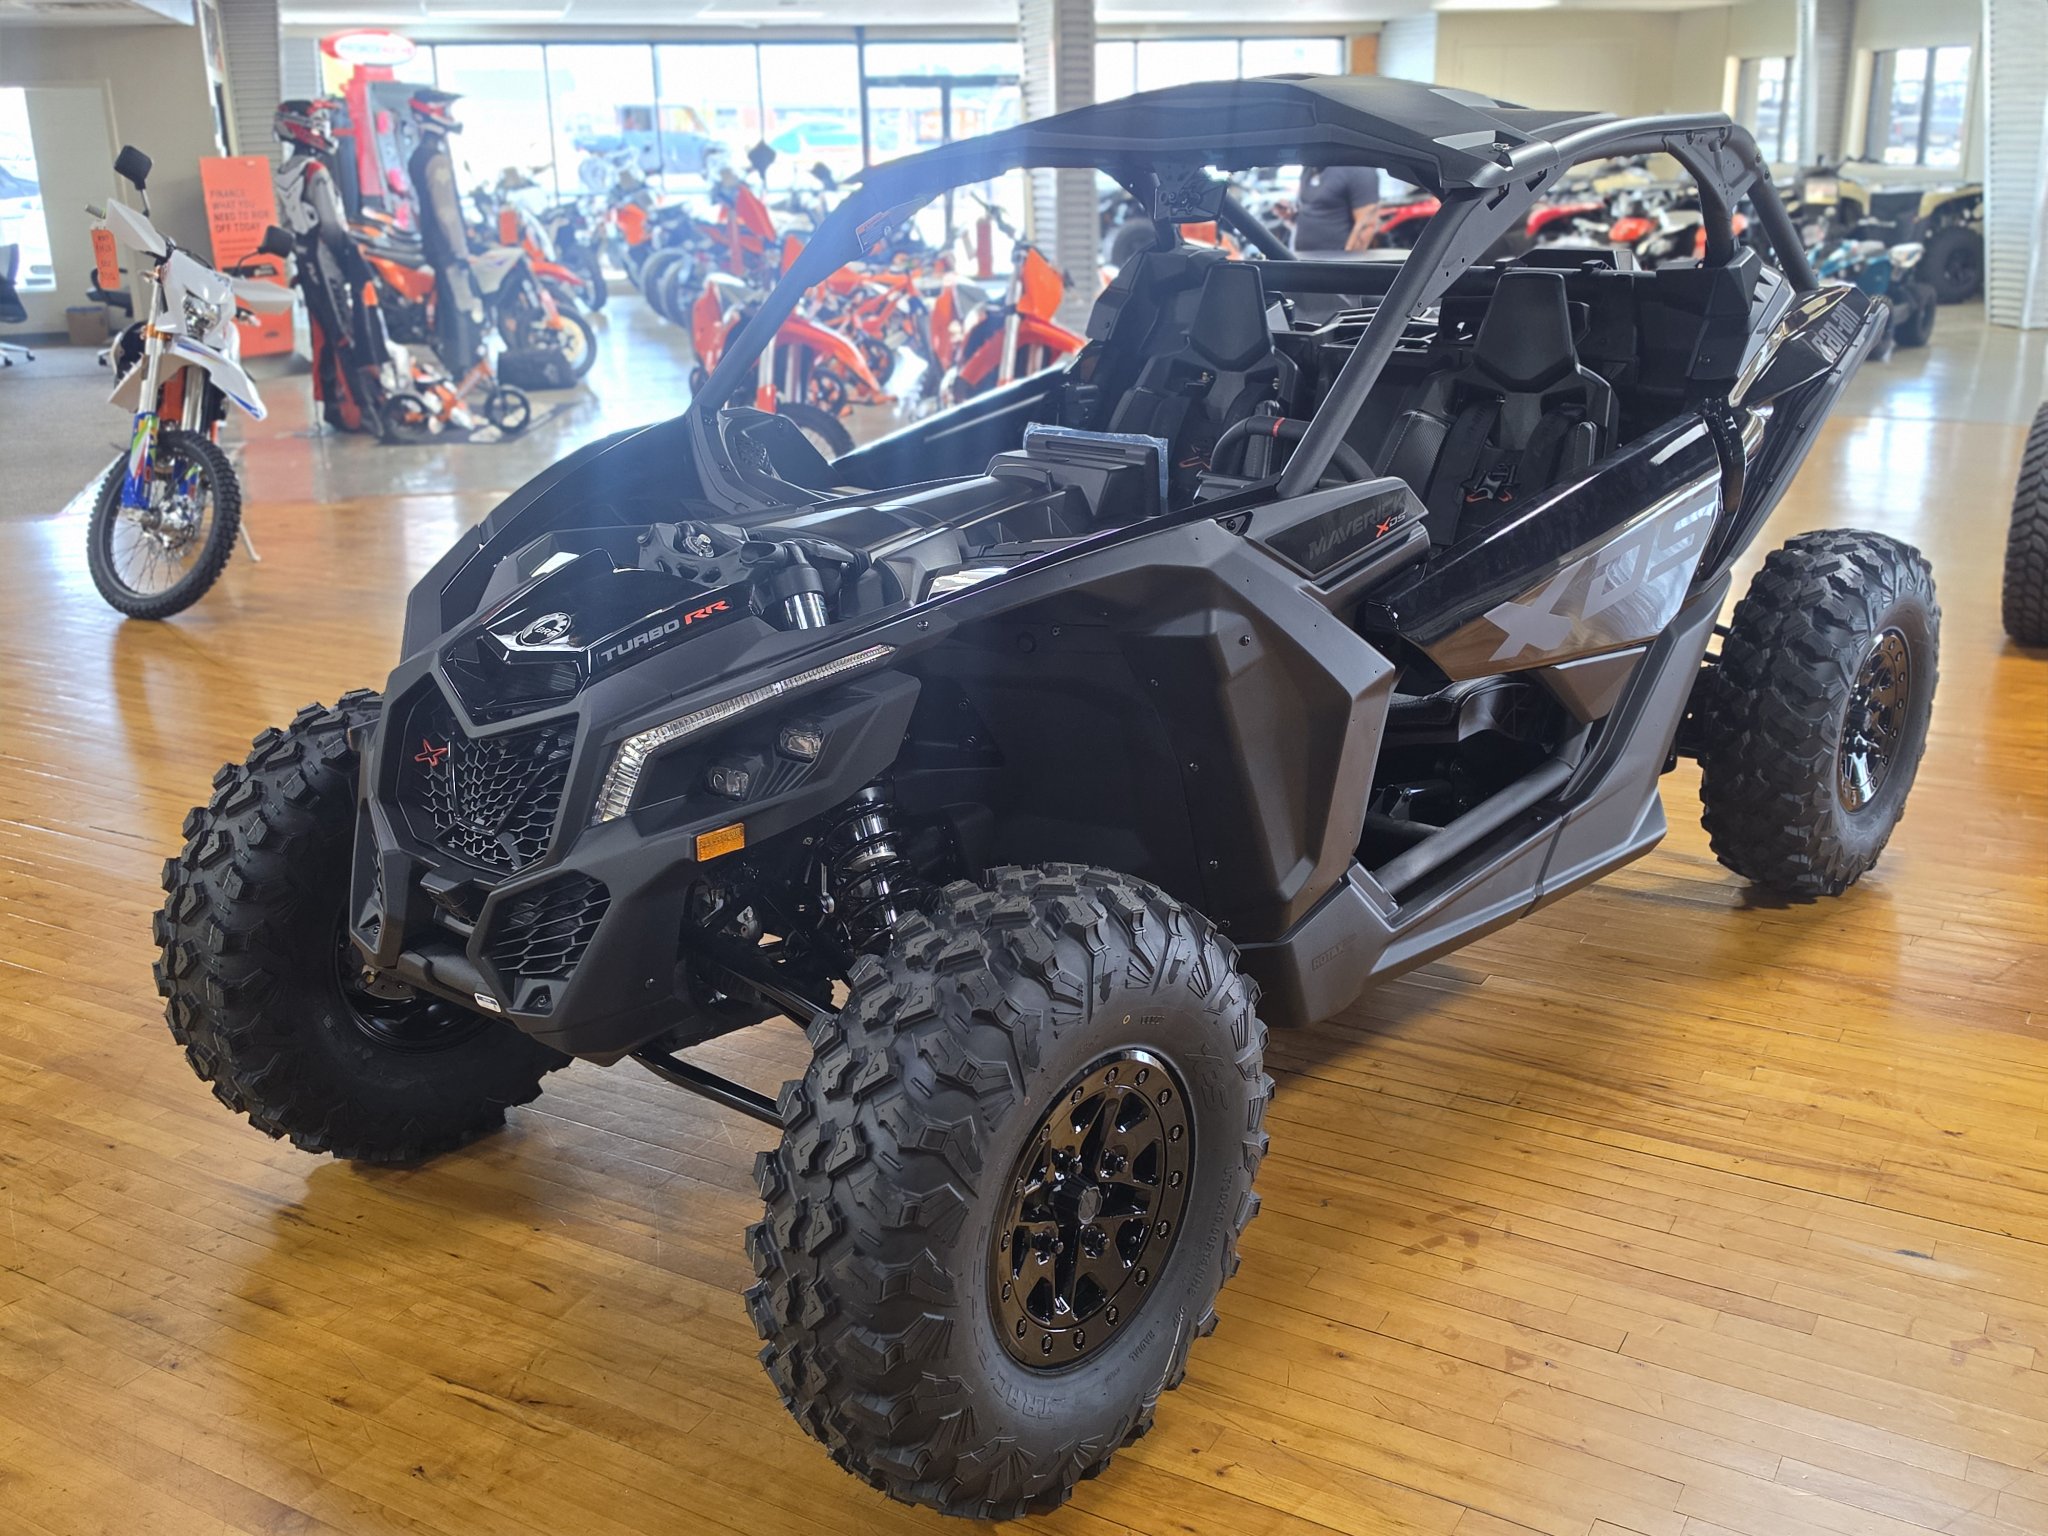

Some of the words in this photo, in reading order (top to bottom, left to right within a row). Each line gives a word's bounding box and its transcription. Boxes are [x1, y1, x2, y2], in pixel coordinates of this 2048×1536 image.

[214, 212, 236, 221] NEED
[239, 211, 249, 220] TO
[216, 223, 231, 233] OFF
[234, 222, 260, 232] TODAY
[600, 619, 681, 662] TURBO
[684, 600, 730, 625] RR
